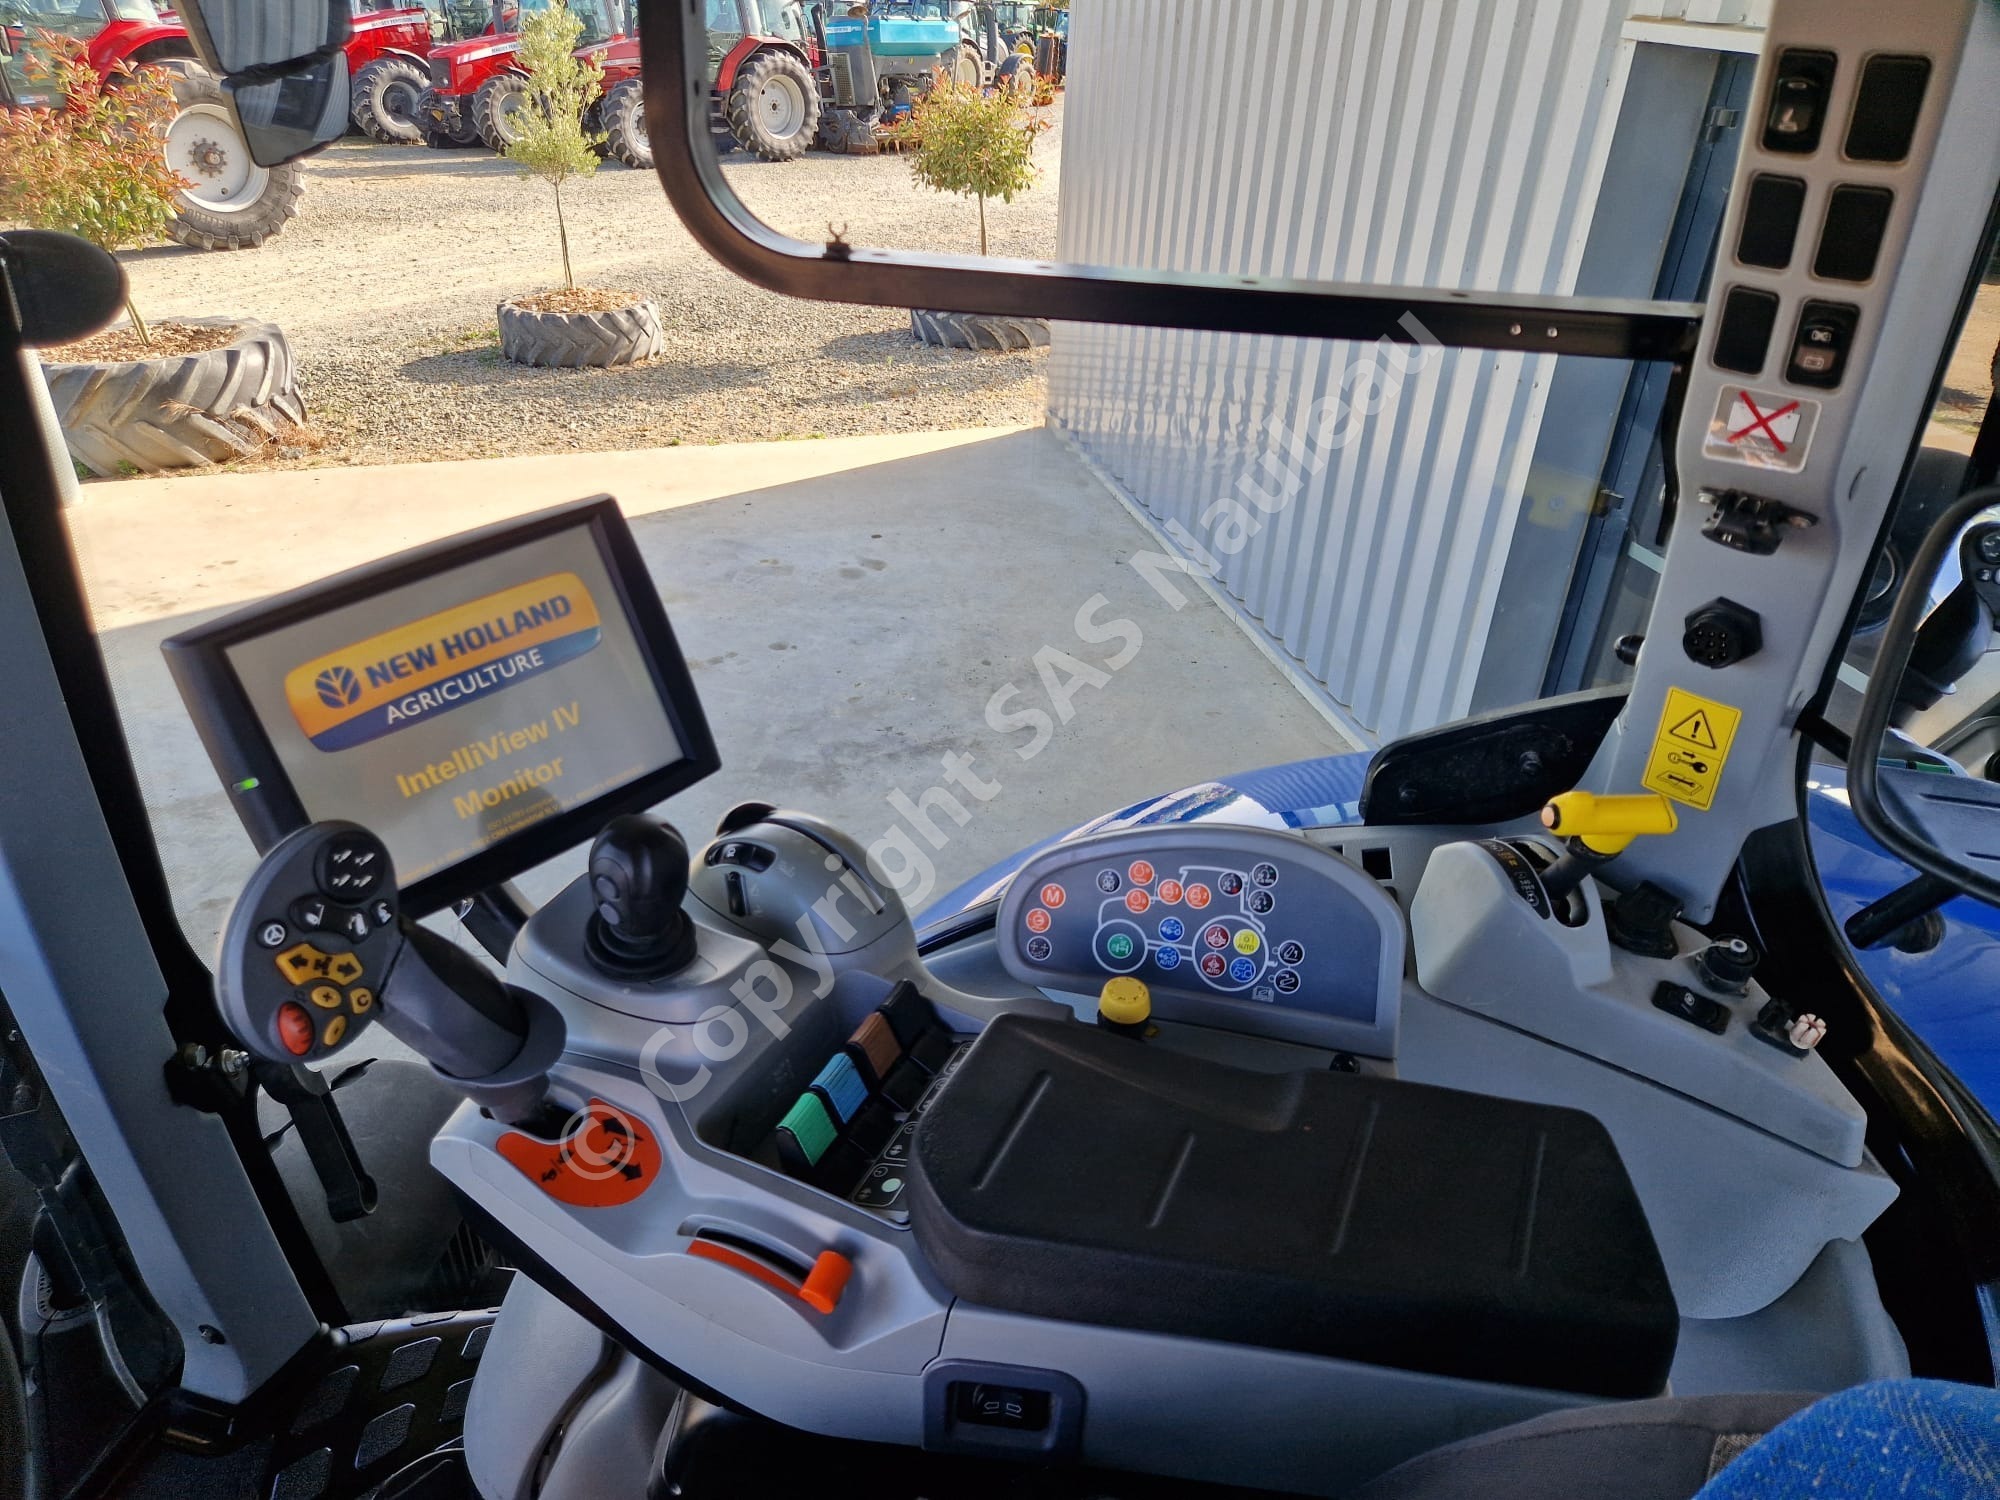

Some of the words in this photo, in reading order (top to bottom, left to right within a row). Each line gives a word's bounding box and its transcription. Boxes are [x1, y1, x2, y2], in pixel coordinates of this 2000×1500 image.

[365, 644, 437, 689] NEW
[441, 594, 572, 660] HOLLAND
[387, 648, 544, 725] AGRICULTURE
[396, 720, 549, 798] IntelliView
[552, 702, 581, 732] IV
[453, 756, 564, 820] Monitor
[1046, 890, 1060, 902] M
[1237, 943, 1254, 951] AUTO
